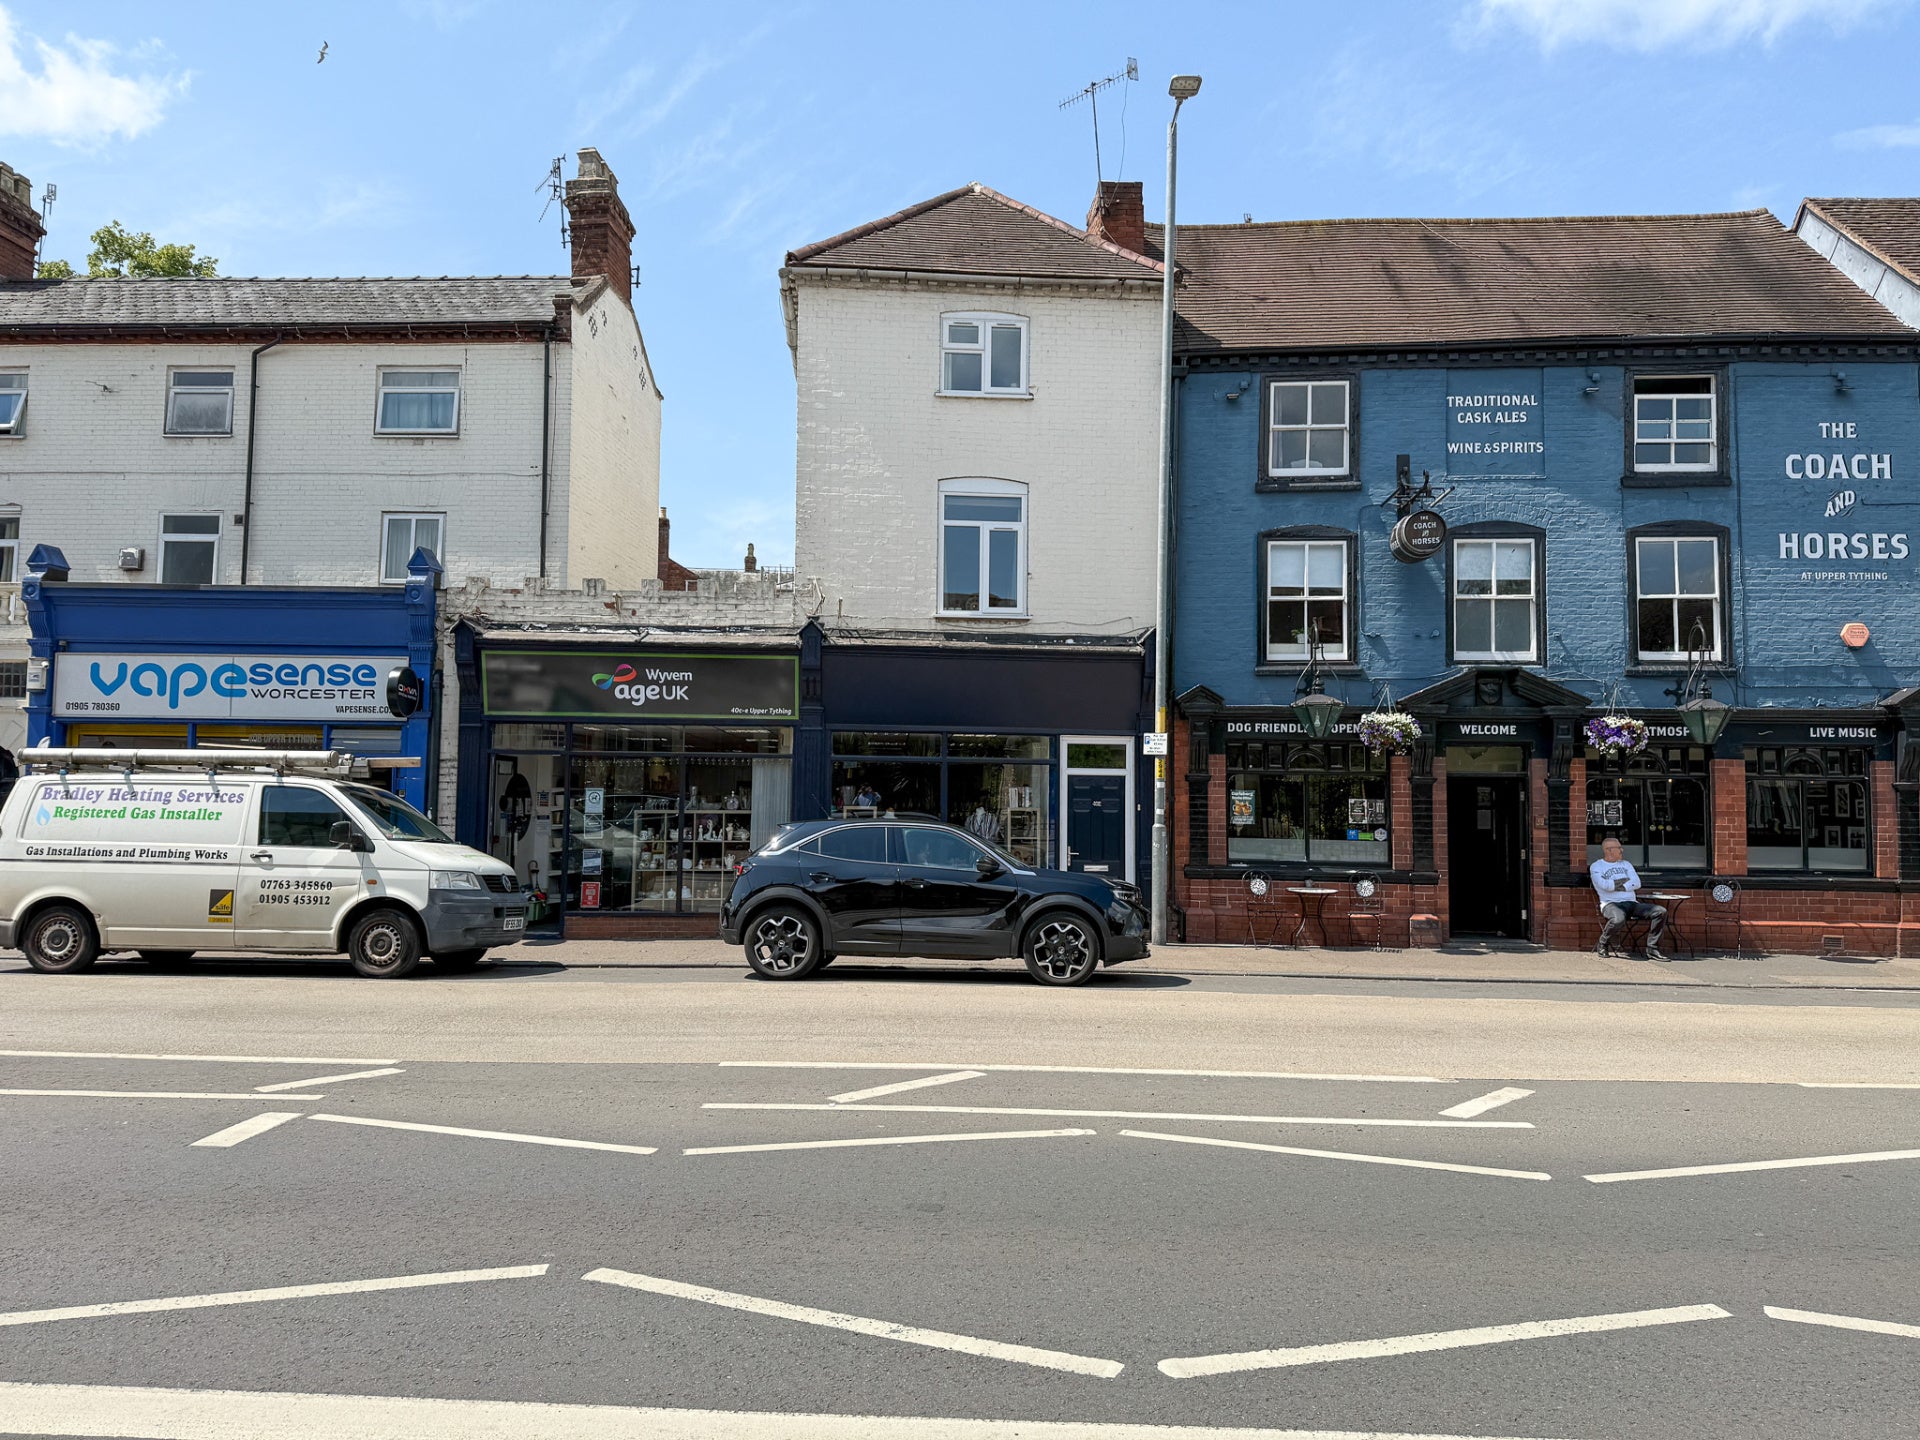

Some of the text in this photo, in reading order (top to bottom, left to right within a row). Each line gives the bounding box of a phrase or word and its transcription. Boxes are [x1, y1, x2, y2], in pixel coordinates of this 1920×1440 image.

[1446, 394, 1538, 407] TRADITIONAL
[1457, 411, 1527, 423] CASK ALES
[1818, 422, 1859, 438] THE
[1447, 442, 1482, 454] WINE
[1493, 442, 1544, 454] SPIRITS
[1785, 453, 1892, 479] COACH
[1824, 490, 1856, 517] AND
[1413, 521, 1437, 529] COACH
[1412, 536, 1440, 545] HORSES
[1779, 533, 1909, 559] HORSES
[1800, 571, 1888, 581] AT UPPER TYTHING
[645, 668, 693, 684] Wyvern
[250, 688, 376, 700] WORCESTER
[65, 702, 121, 711] 01905 780360
[749, 707, 768, 715] Upper
[768, 707, 792, 716] Tything
[1227, 722, 1252, 733] DOG
[1459, 724, 1517, 735] WELCOME
[1809, 727, 1877, 738] LIVE MUSIC
[41, 787, 244, 805] Bradley Heating Services
[53, 806, 223, 821] Registered Gas Installer
[26, 846, 229, 861] Gas Installations and Plumbing Works
[260, 880, 333, 891] 07763 345860
[259, 894, 331, 905] 01905 453912
